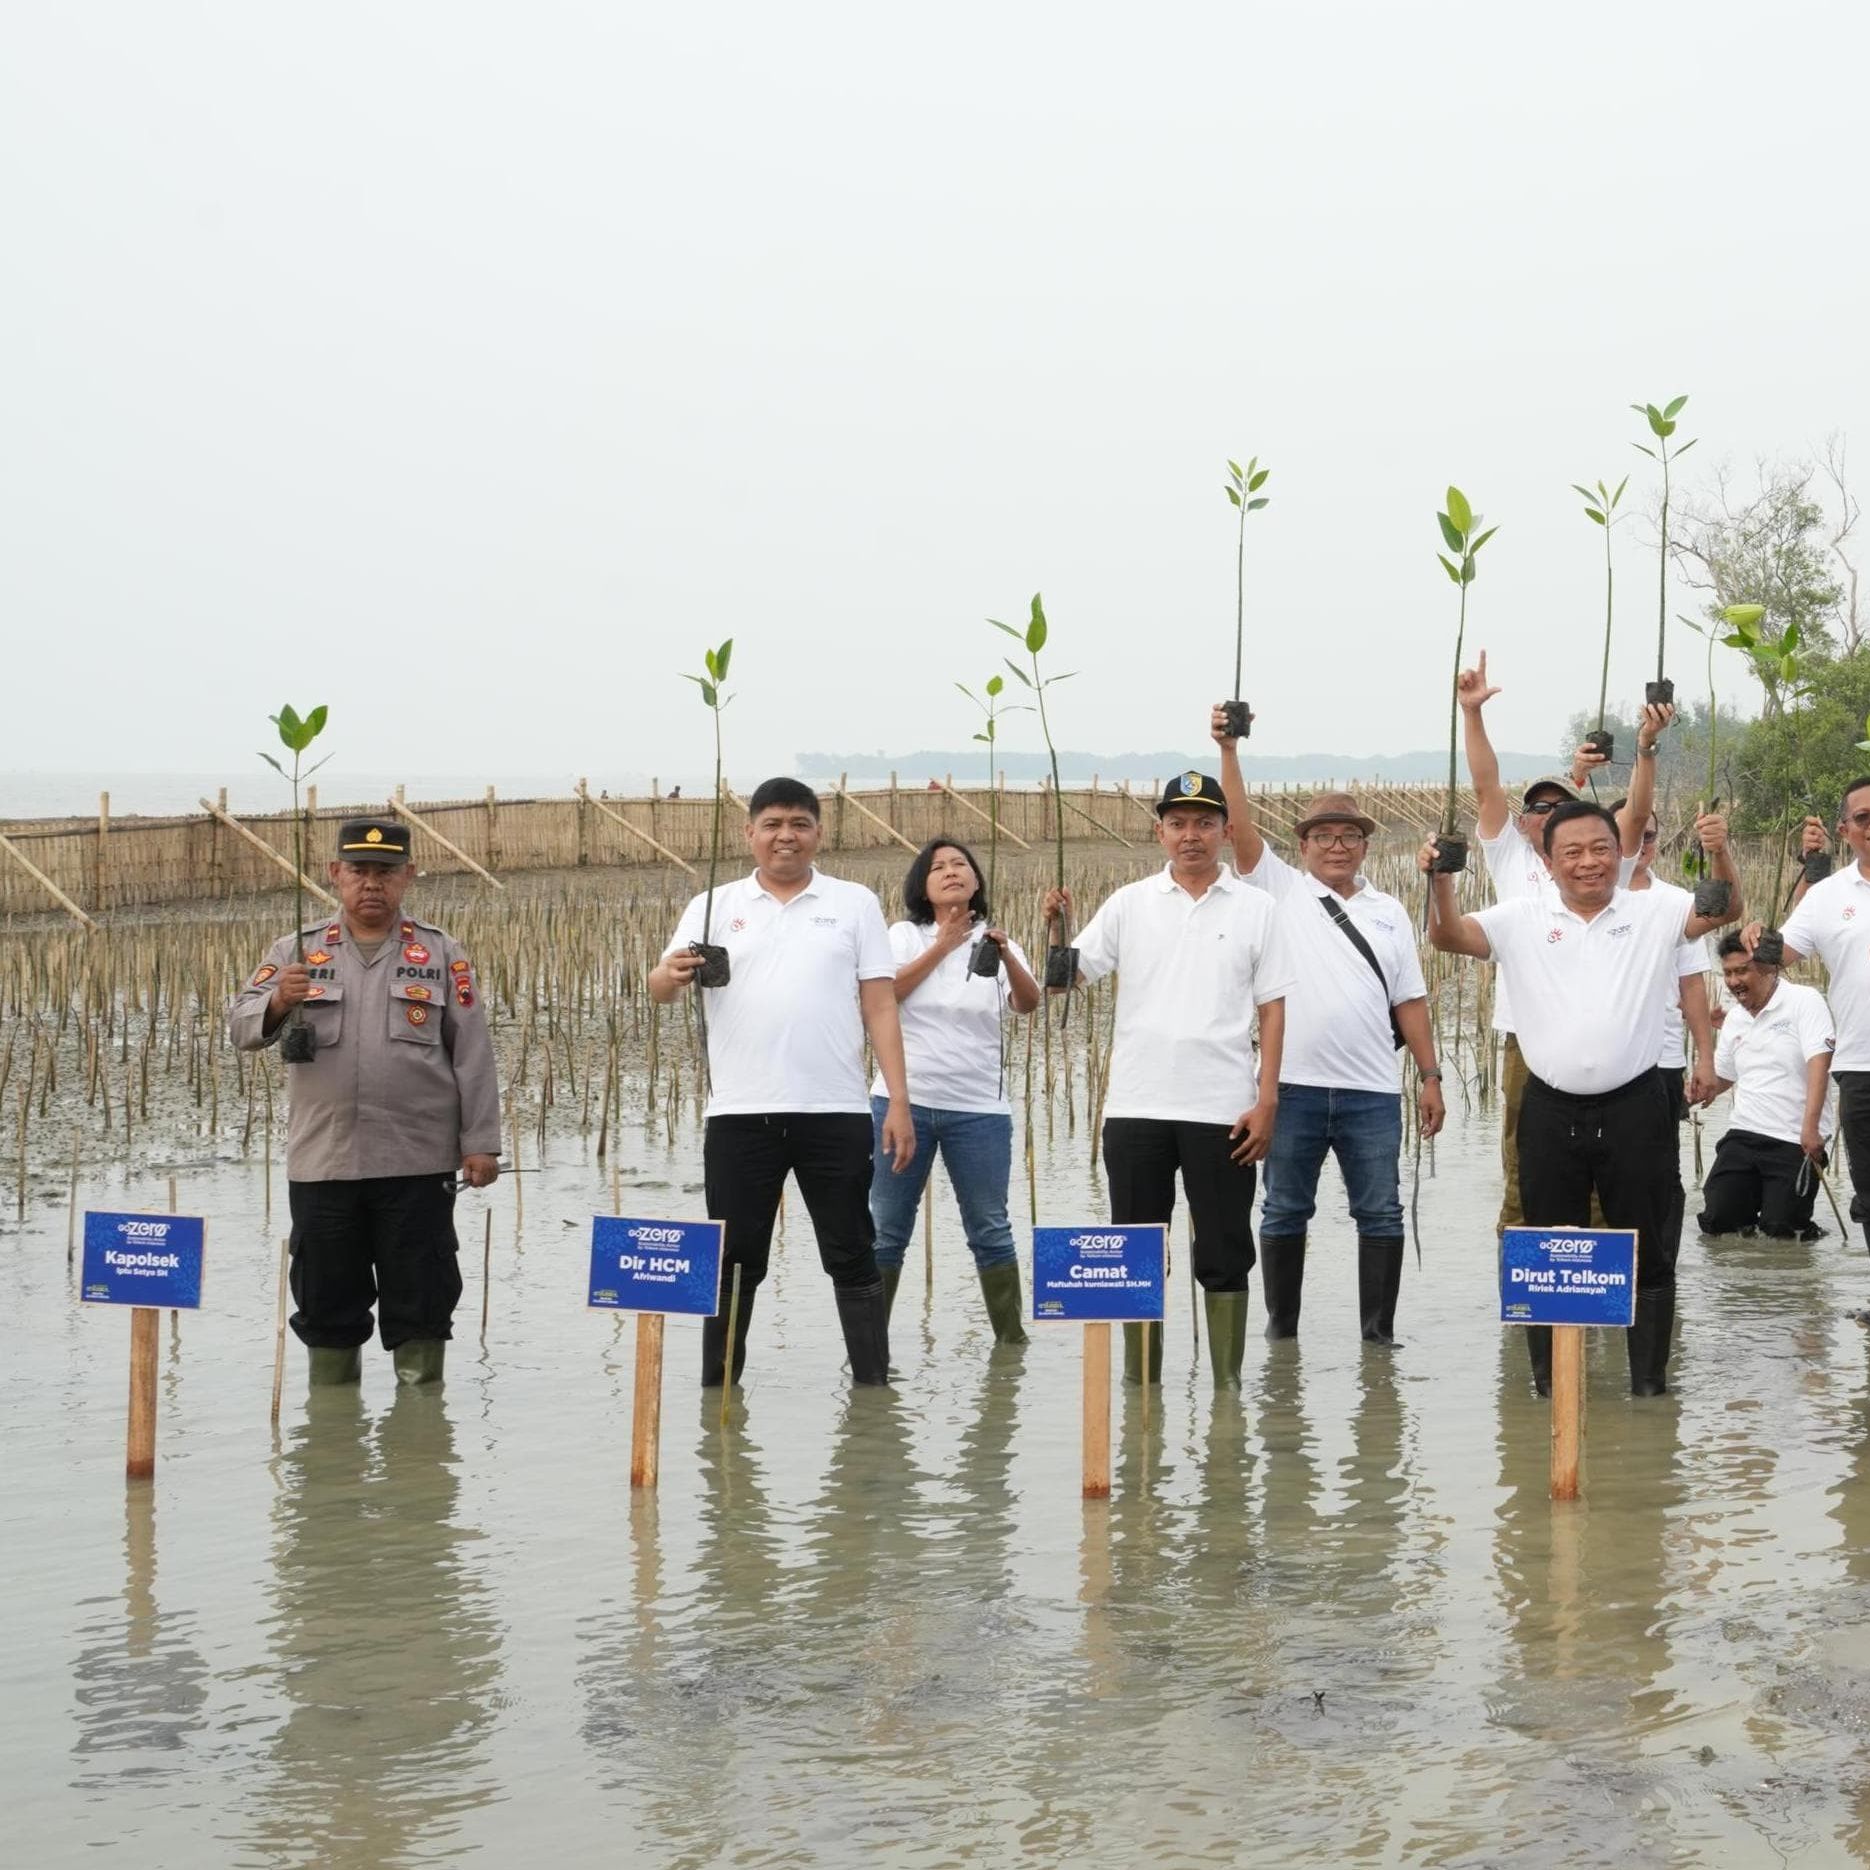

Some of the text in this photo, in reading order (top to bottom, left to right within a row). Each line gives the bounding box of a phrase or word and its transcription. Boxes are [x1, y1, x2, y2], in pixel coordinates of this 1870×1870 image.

[310, 969, 335, 980] ERI
[396, 966, 440, 980] POLRI
[105, 1250, 179, 1268] Kapolsek
[619, 1255, 690, 1274] Dir HCM
[632, 1272, 676, 1282] Afriwandi
[1070, 1265, 1128, 1279] Camat
[1511, 1268, 1626, 1285] Dirut Telkom
[1556, 1285, 1607, 1295] Adriansyah
